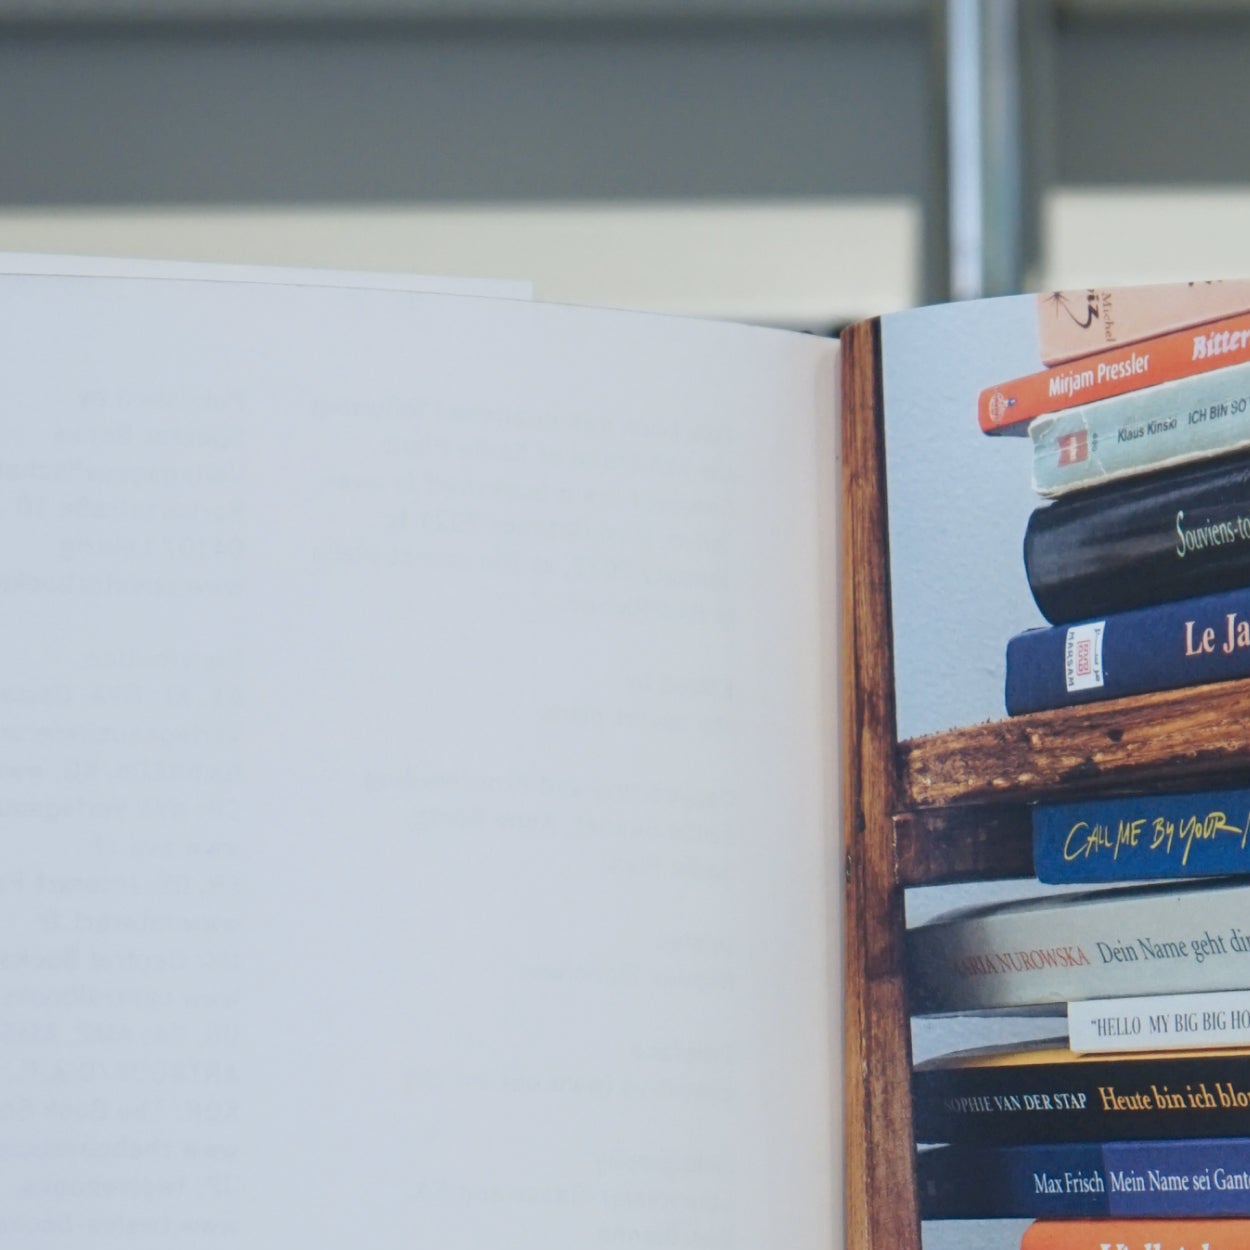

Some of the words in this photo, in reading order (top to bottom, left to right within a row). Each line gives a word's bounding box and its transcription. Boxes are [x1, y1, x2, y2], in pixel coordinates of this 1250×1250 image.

[1101, 292, 1117, 343] Michel
[1049, 368, 1094, 398] Mirjam
[1097, 352, 1150, 384] Pressler
[1188, 409, 1207, 425] ICH
[1209, 405, 1228, 421] BIN
[1230, 400, 1247, 414] SO
[1117, 427, 1144, 443] Klaus
[1147, 417, 1178, 436] Kinski
[1185, 621, 1215, 656] Le
[1064, 821, 1113, 861] CALL
[1113, 819, 1147, 860] ME
[1179, 811, 1243, 866] YOUR
[995, 945, 1091, 974] NUROWSKA
[1096, 941, 1139, 965] Dein
[1137, 936, 1190, 962] Name
[1190, 930, 1228, 964] geht
[1149, 1012, 1171, 1034] MY
[1174, 1011, 1198, 1033] BIG
[1202, 1010, 1227, 1031] BIG
[993, 1094, 1022, 1112] VAN
[1023, 1093, 1054, 1111] DER
[1053, 1091, 1087, 1110] STAP
[1098, 1086, 1153, 1111] Heute
[1150, 1084, 1187, 1109] bin
[1186, 1082, 1218, 1109] ich
[1032, 1171, 1064, 1194] Max
[1063, 1170, 1105, 1194] Frisch
[1109, 1168, 1146, 1192] Mein
[1147, 1169, 1190, 1192] Name
[1192, 1168, 1211, 1191] sei
